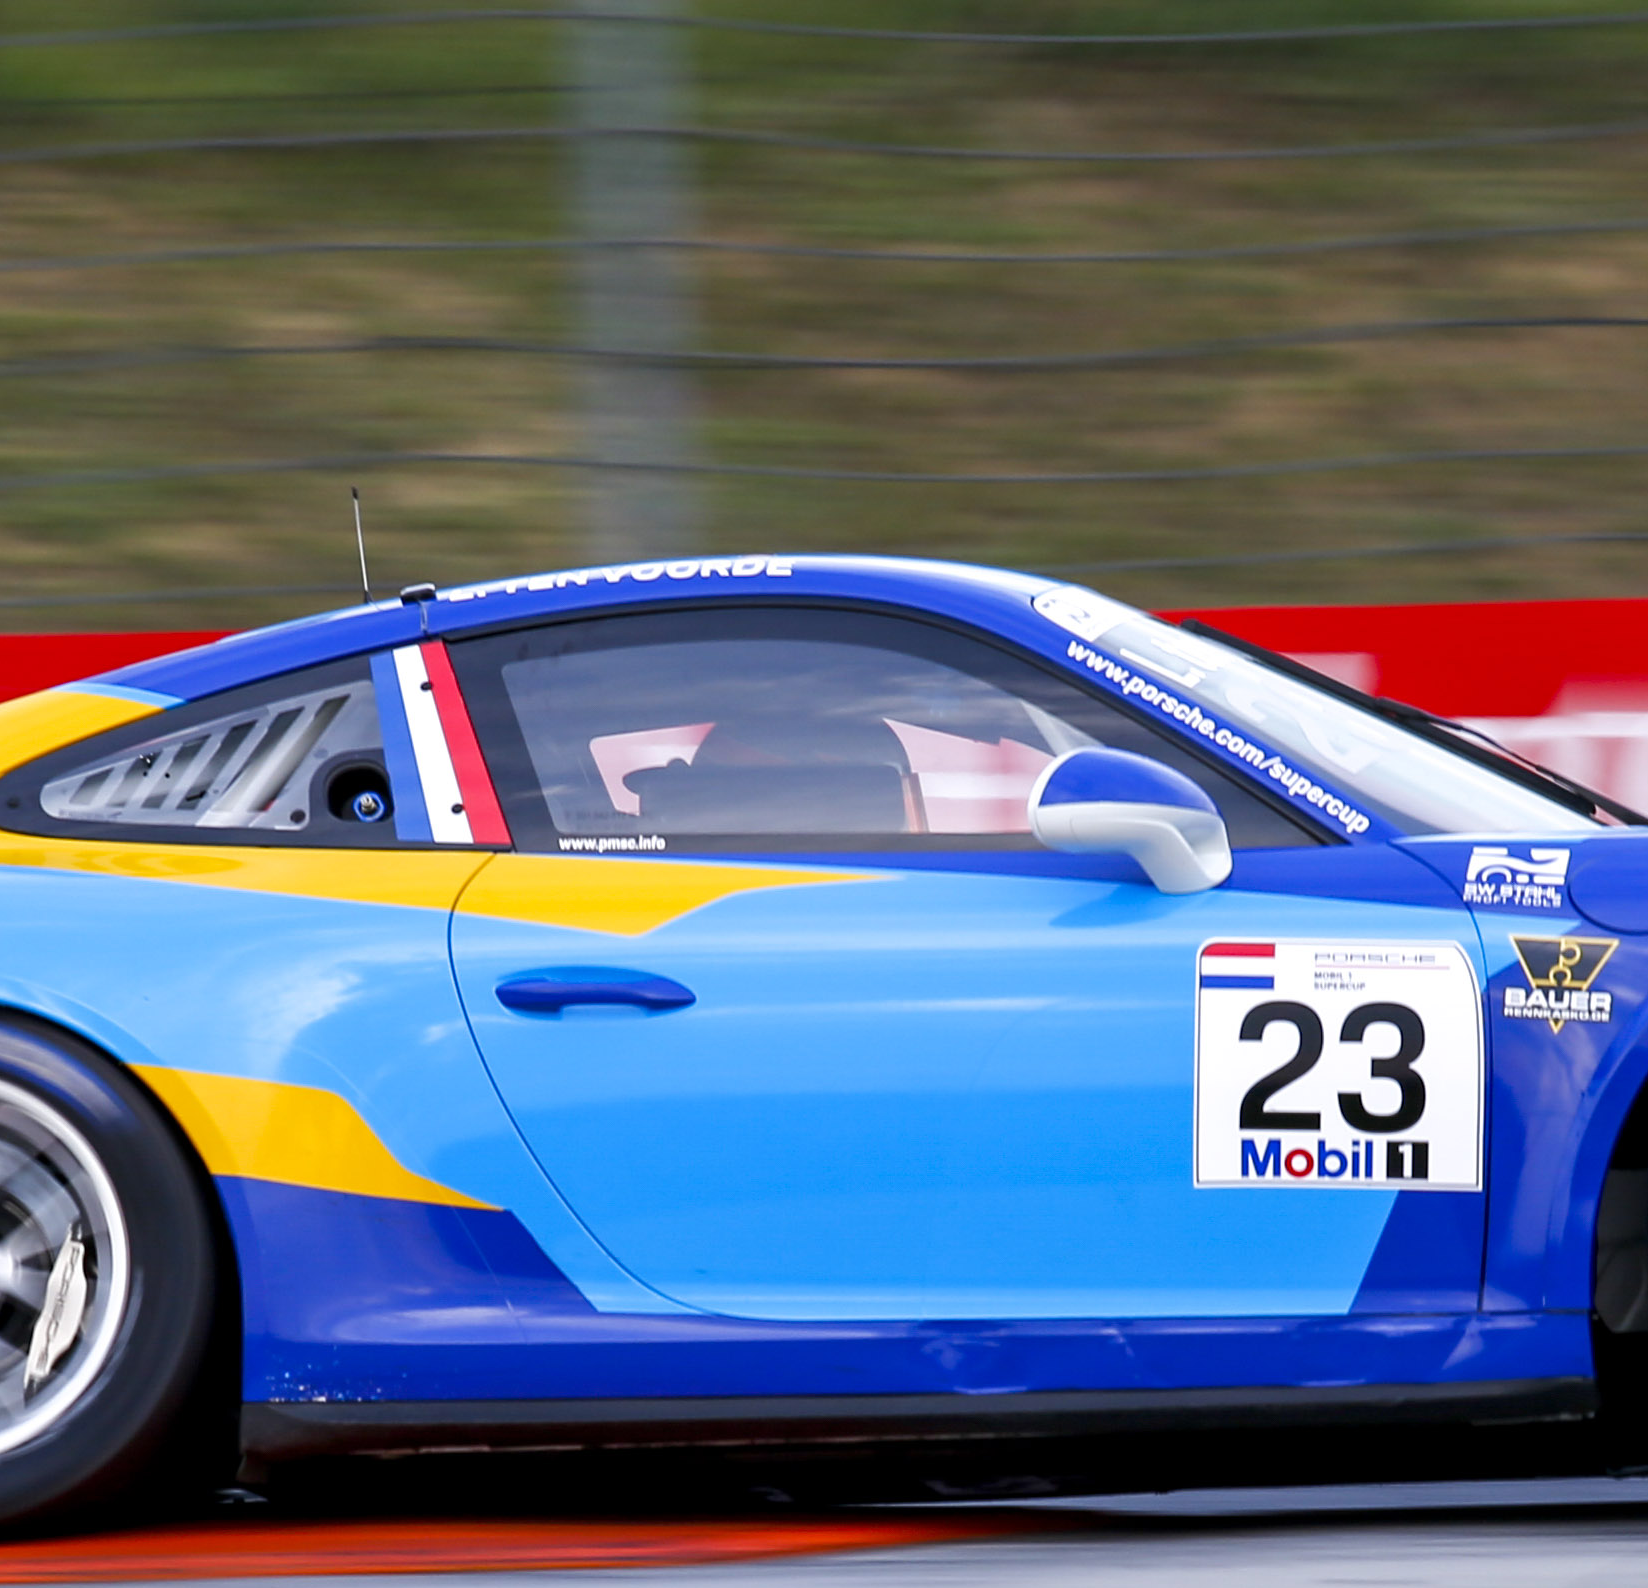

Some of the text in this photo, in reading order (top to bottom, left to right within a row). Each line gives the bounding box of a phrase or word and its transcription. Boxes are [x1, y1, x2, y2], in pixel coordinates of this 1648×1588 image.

[601, 557, 796, 583] VOORDE
[1066, 640, 1371, 835] www.porsche.com/supercup
[1314, 952, 1436, 963] PORSCHE
[1314, 971, 1343, 980] MOBIL
[1314, 981, 1366, 991] SUPERCUP
[1504, 986, 1612, 1012] BAUER
[1238, 1000, 1427, 1134] 23
[1240, 1138, 1418, 1179] Mobil 1
